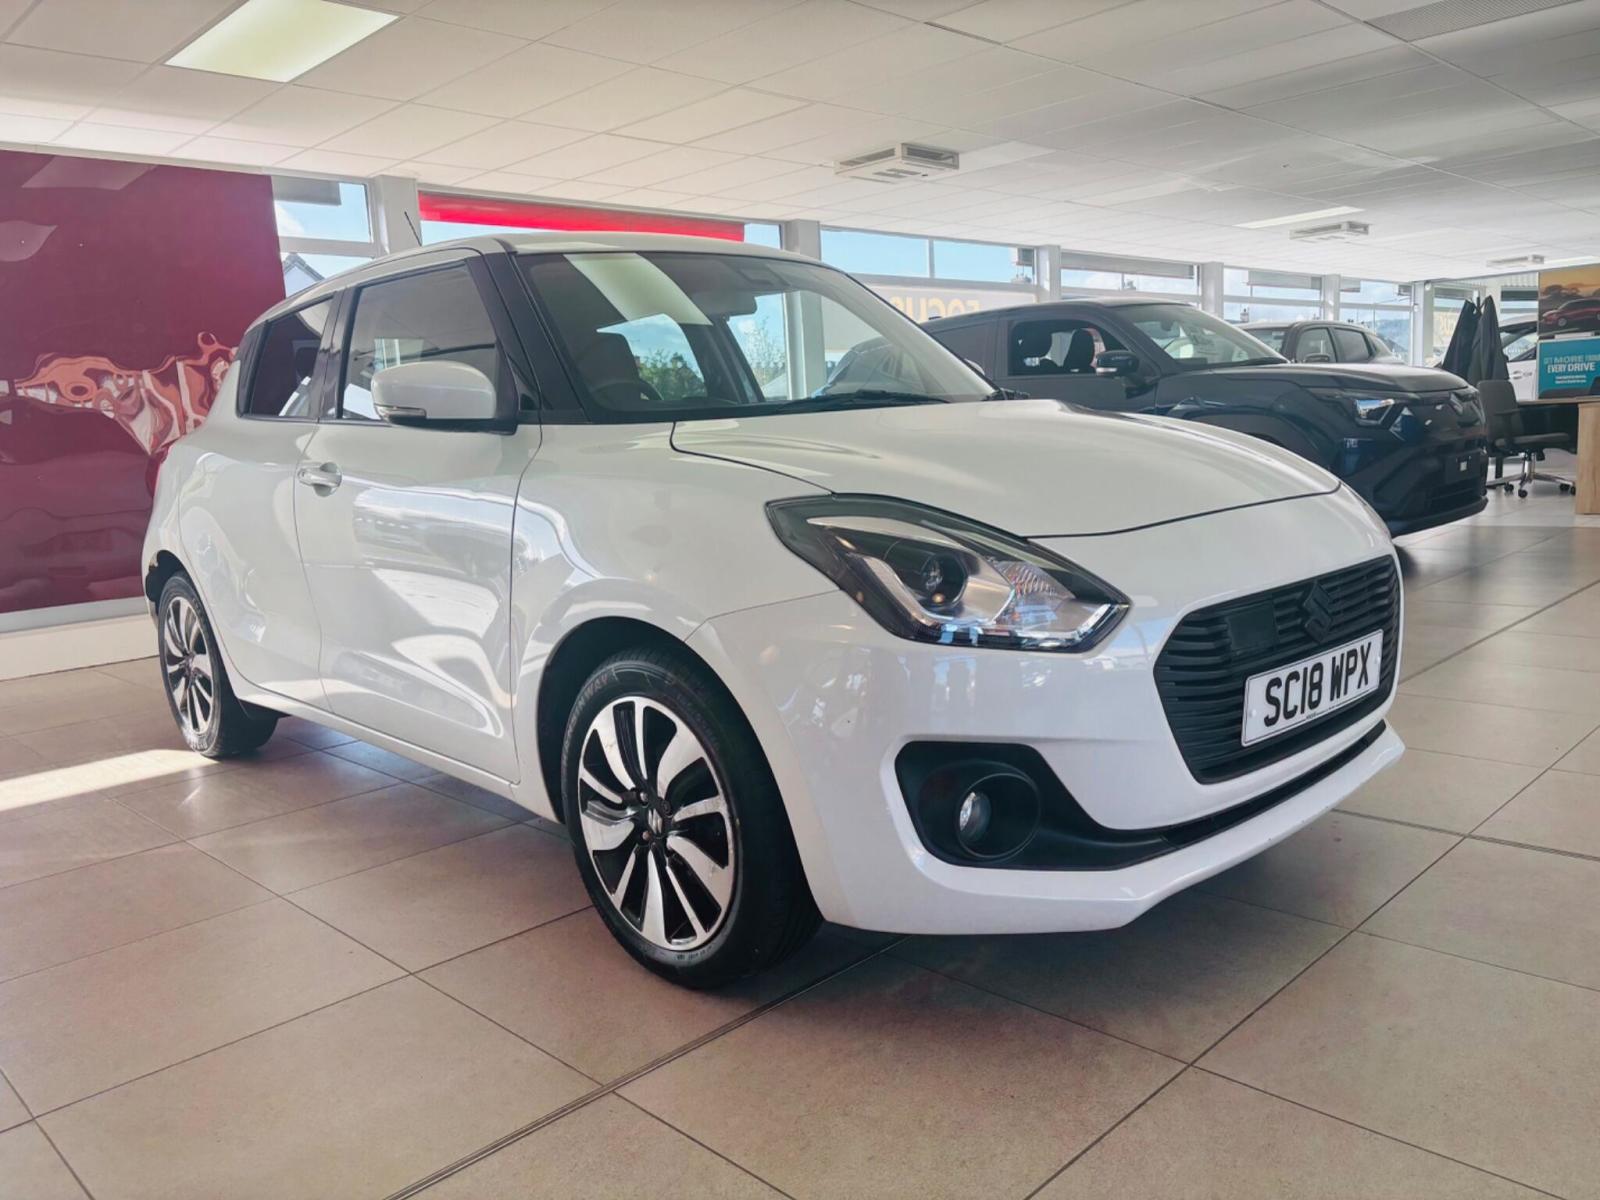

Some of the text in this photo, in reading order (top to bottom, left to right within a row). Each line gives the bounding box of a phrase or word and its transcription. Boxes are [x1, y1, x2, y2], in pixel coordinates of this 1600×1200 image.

[1547, 361, 1596, 374] EVERY DRIVE
[1263, 642, 1372, 727] SC18 WPX
